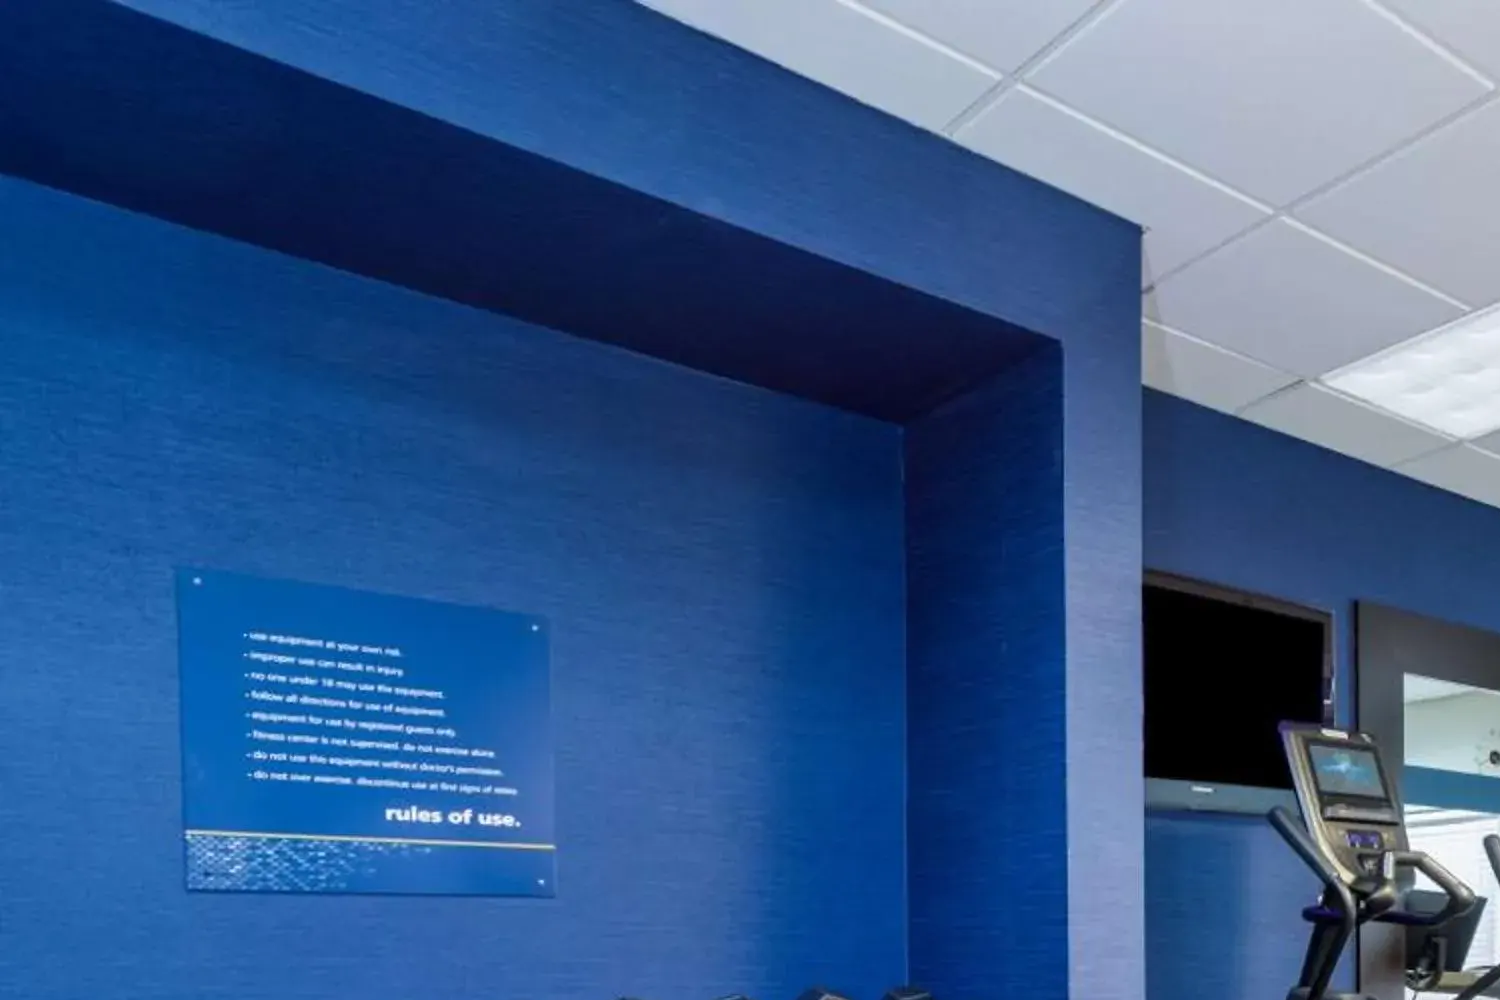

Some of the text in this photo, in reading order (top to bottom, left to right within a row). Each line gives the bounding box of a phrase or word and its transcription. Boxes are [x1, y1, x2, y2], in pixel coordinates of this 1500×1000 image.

[385, 805, 522, 828] rules of use.
